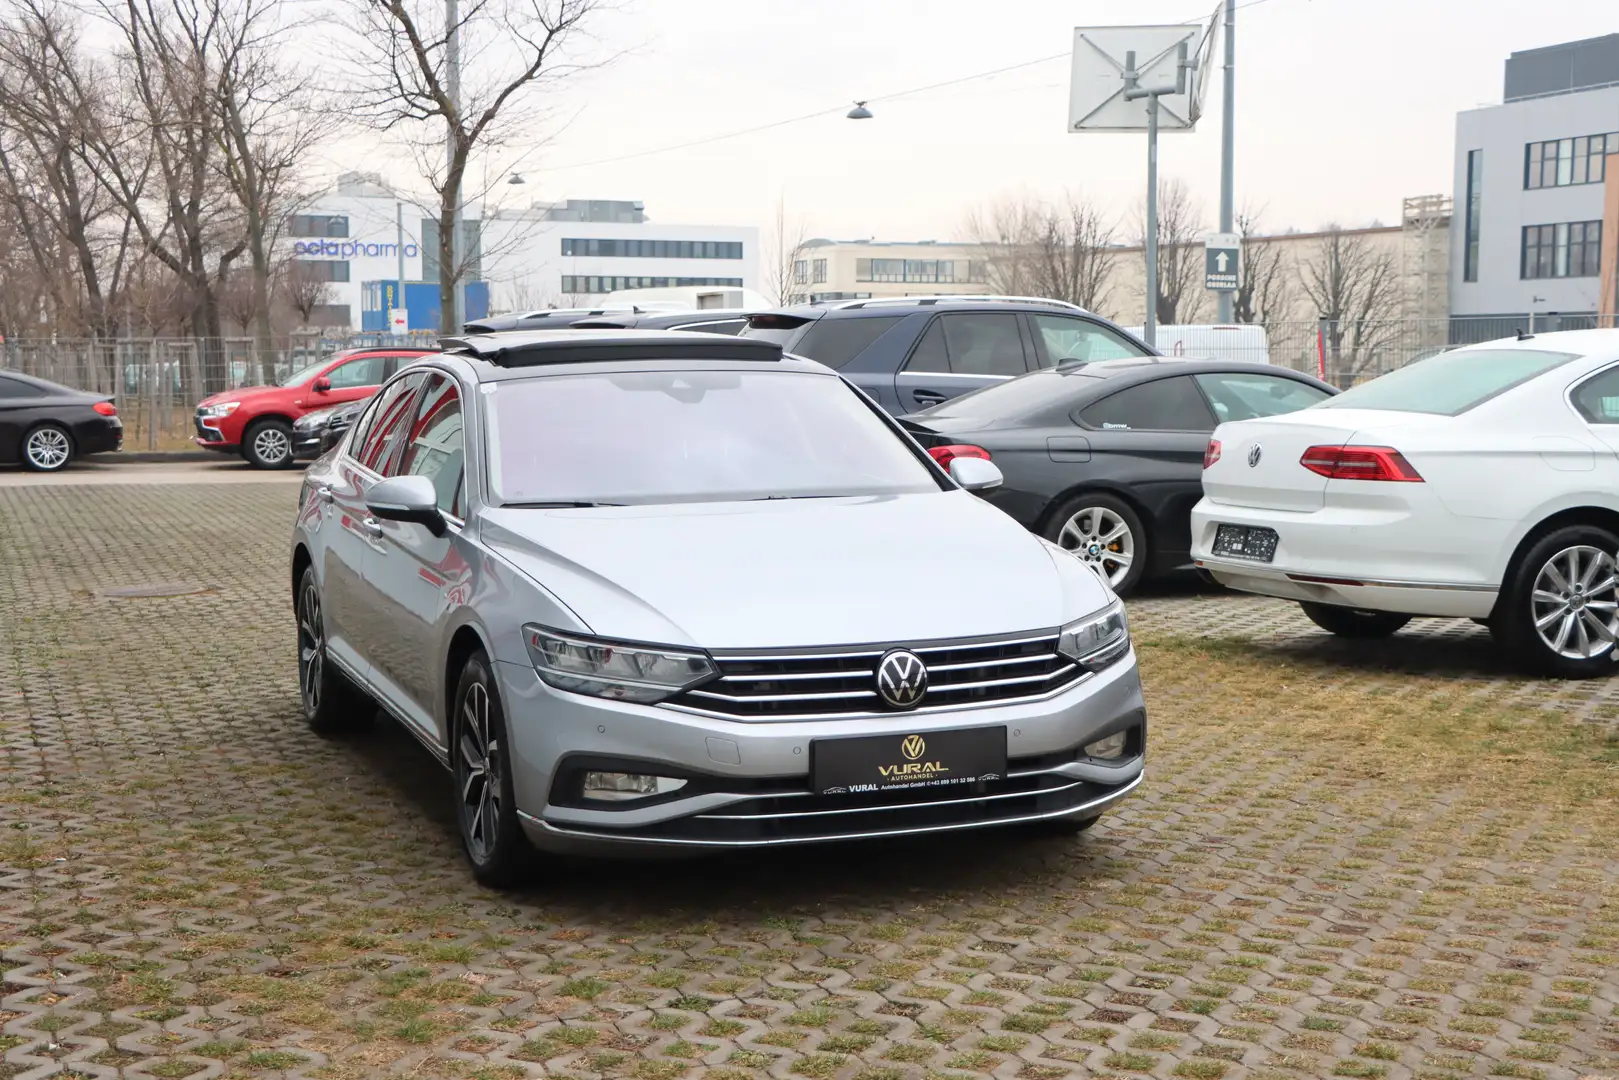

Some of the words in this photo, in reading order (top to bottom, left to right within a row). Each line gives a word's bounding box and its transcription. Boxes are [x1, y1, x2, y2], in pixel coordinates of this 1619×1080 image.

[294, 239, 418, 259] octapharma
[878, 761, 949, 776] VURAL
[890, 773, 934, 781] AUTOHANDEL
[849, 784, 879, 793] VURAL
